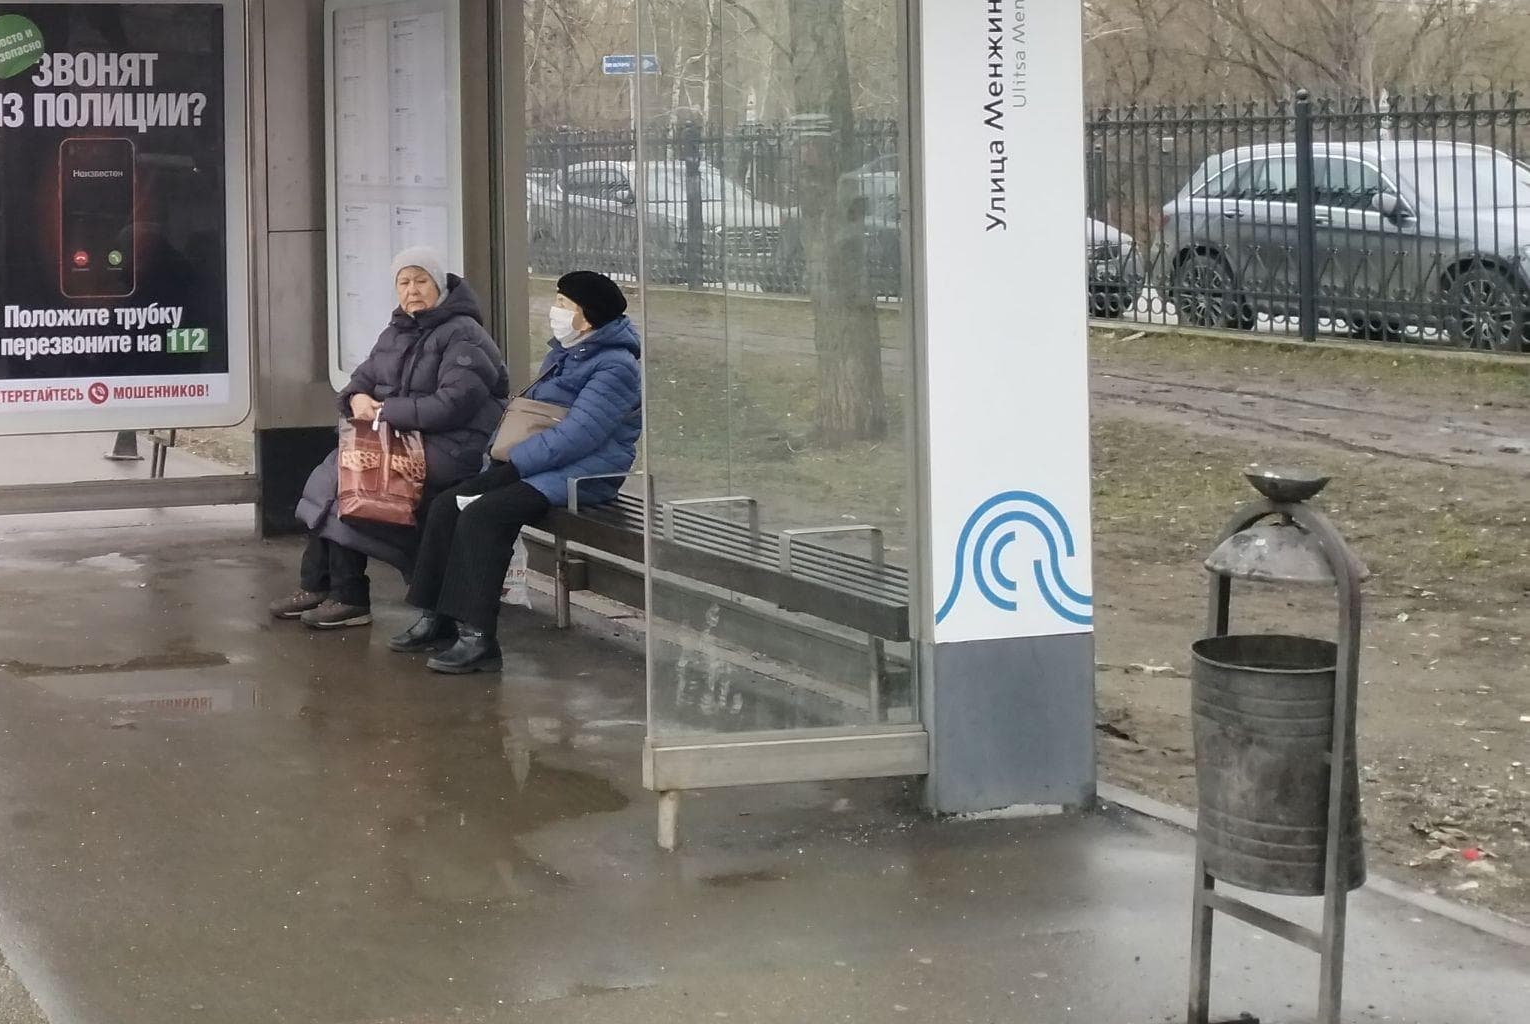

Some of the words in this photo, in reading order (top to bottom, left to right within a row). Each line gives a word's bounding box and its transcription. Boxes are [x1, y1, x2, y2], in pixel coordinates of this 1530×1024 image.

[25, 29, 33, 38] и
[31, 52, 159, 87] ЗВОНЯТ
[1011, 50, 1027, 108] Ulitsa
[34, 92, 207, 133] ПОЛИЦИИ?
[985, 140, 1008, 231] Улица
[4, 305, 110, 328] Положите
[113, 302, 183, 330] трубку
[0, 334, 132, 360] перезвоните
[137, 333, 162, 352] на
[167, 328, 207, 351] 112
[113, 384, 209, 399] МОШЕННИКОВ!
